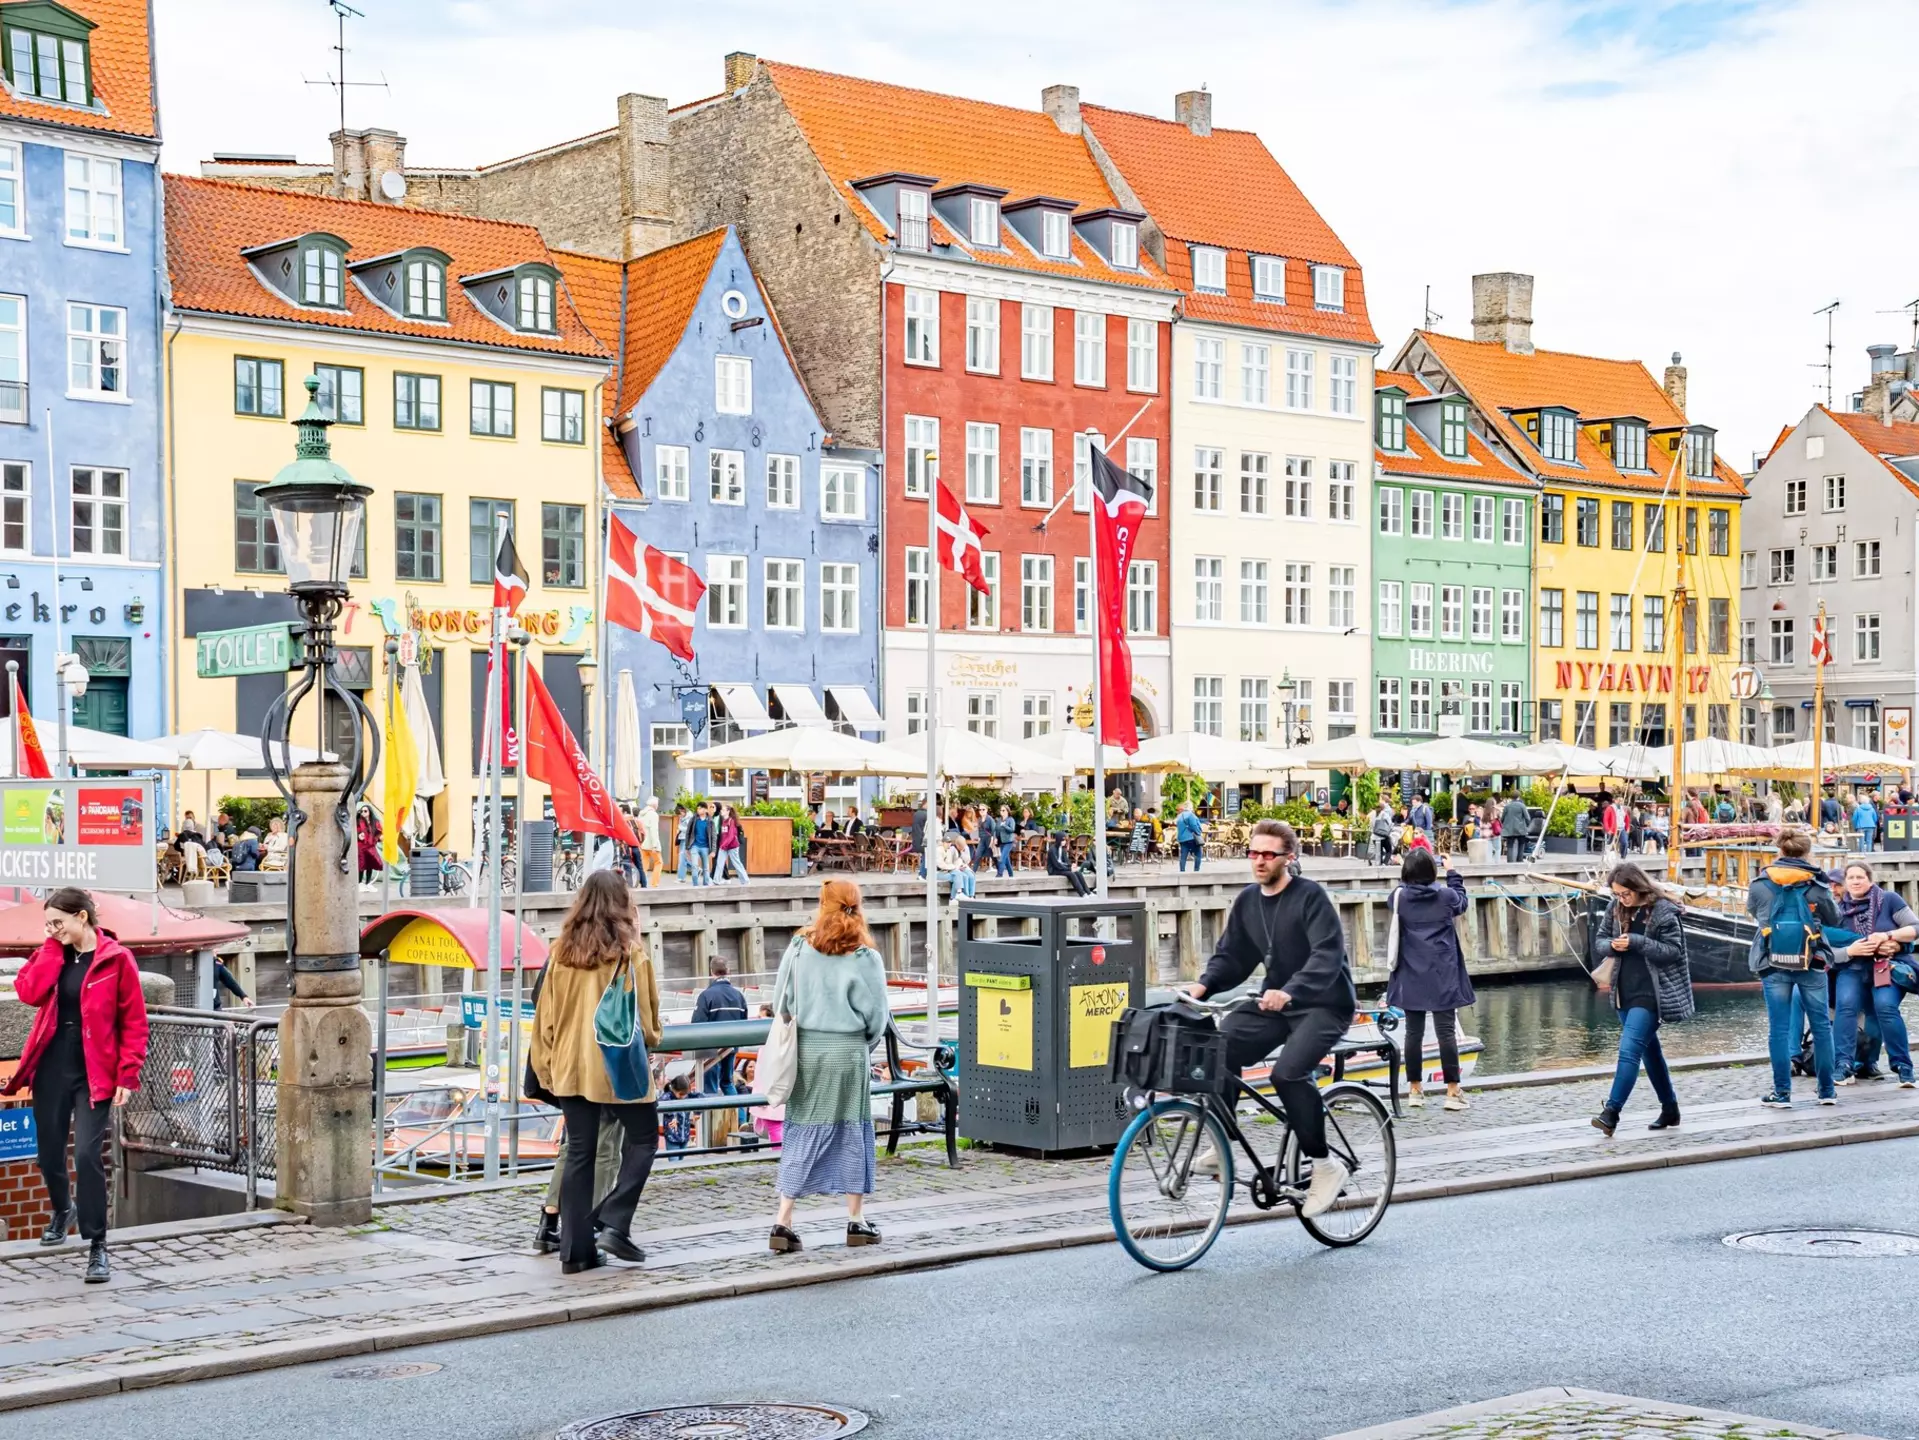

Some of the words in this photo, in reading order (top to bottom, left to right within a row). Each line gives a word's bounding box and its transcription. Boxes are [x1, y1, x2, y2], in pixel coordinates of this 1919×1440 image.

[200, 631, 285, 670] TOILET
[1409, 648, 1494, 673] HEERING
[1555, 660, 1673, 693] NYHAVN
[1687, 665, 1712, 693] 17
[1731, 671, 1754, 697] 17
[88, 805, 120, 815] PANORAMA
[55, 852, 97, 880] HERE
[406, 949, 467, 963] COPENHAGEN
[1771, 954, 1800, 963] PUMA
[1085, 1006, 1114, 1016] MERCI
